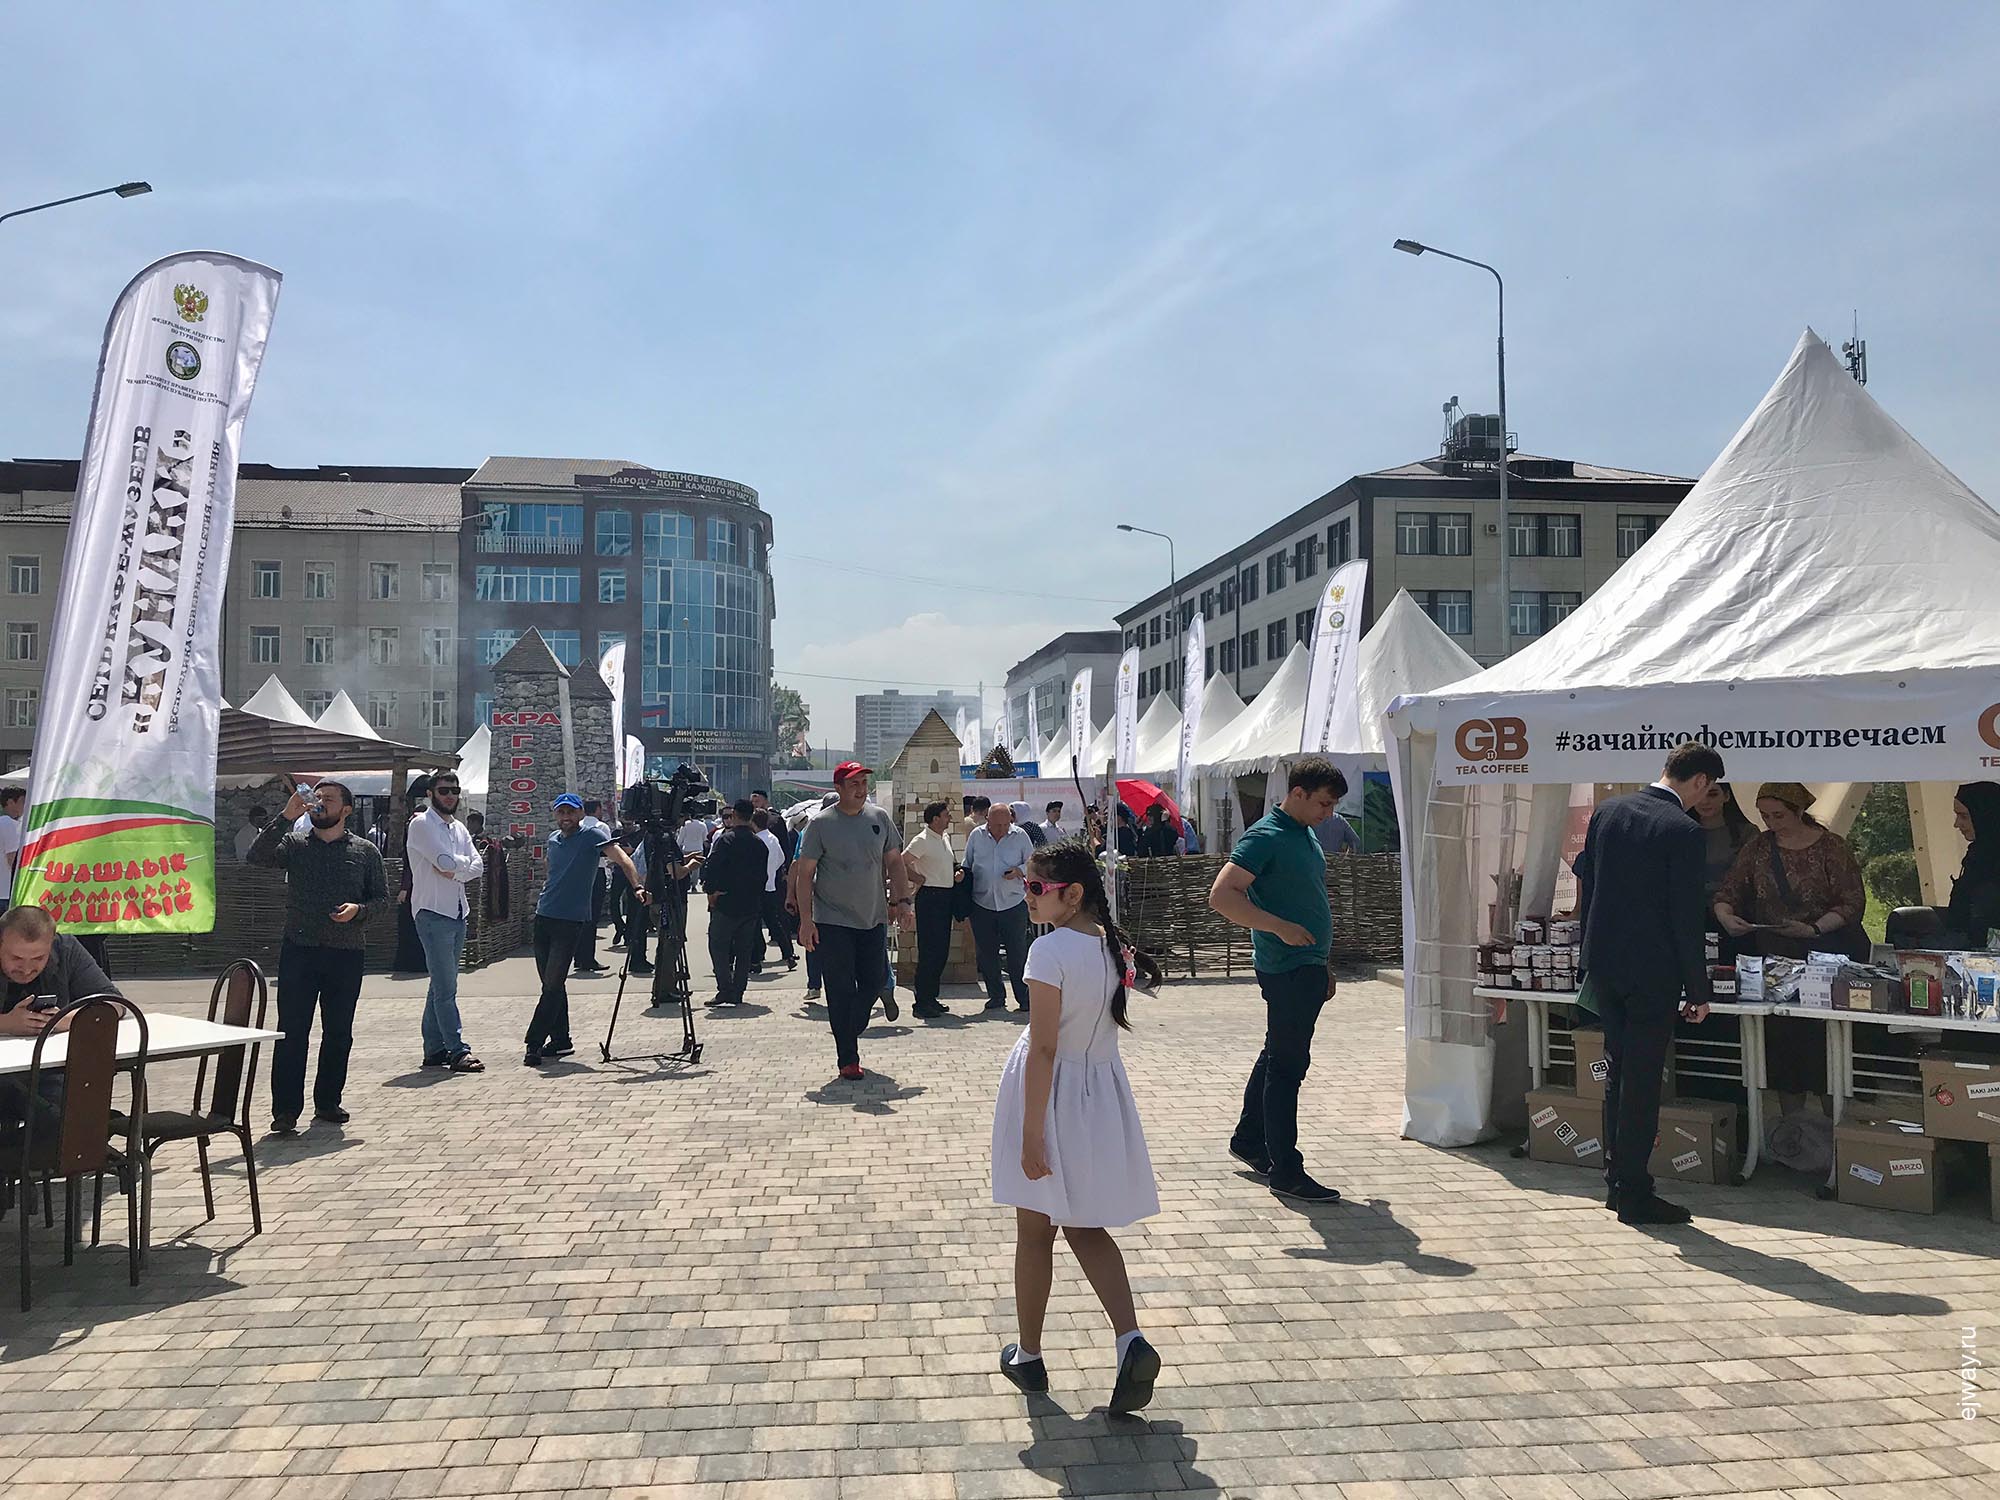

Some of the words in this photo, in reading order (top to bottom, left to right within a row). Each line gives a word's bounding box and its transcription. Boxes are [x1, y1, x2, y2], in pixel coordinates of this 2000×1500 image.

[192, 330, 225, 344] АГЕНТСТВО
[685, 482, 726, 494] КАЖДОГО
[701, 477, 740, 491] СЛУЖЕНИЕ
[86, 646, 115, 723] СЕТЬ
[103, 426, 152, 642] КАФЕ-МУЗЕЕВ
[1455, 717, 1529, 762] GB
[1555, 724, 1947, 752] #зачайкофемыотвечаем
[1979, 756, 2000, 768] TE
[1456, 765, 1478, 776] TEA
[1481, 763, 1529, 775] COFFEE
[44, 853, 188, 883] ШАШЛЫК
[1534, 1110, 1556, 1125] MARZO
[1674, 1154, 1698, 1168] MARZO
[1892, 1162, 1923, 1172] MARZO
